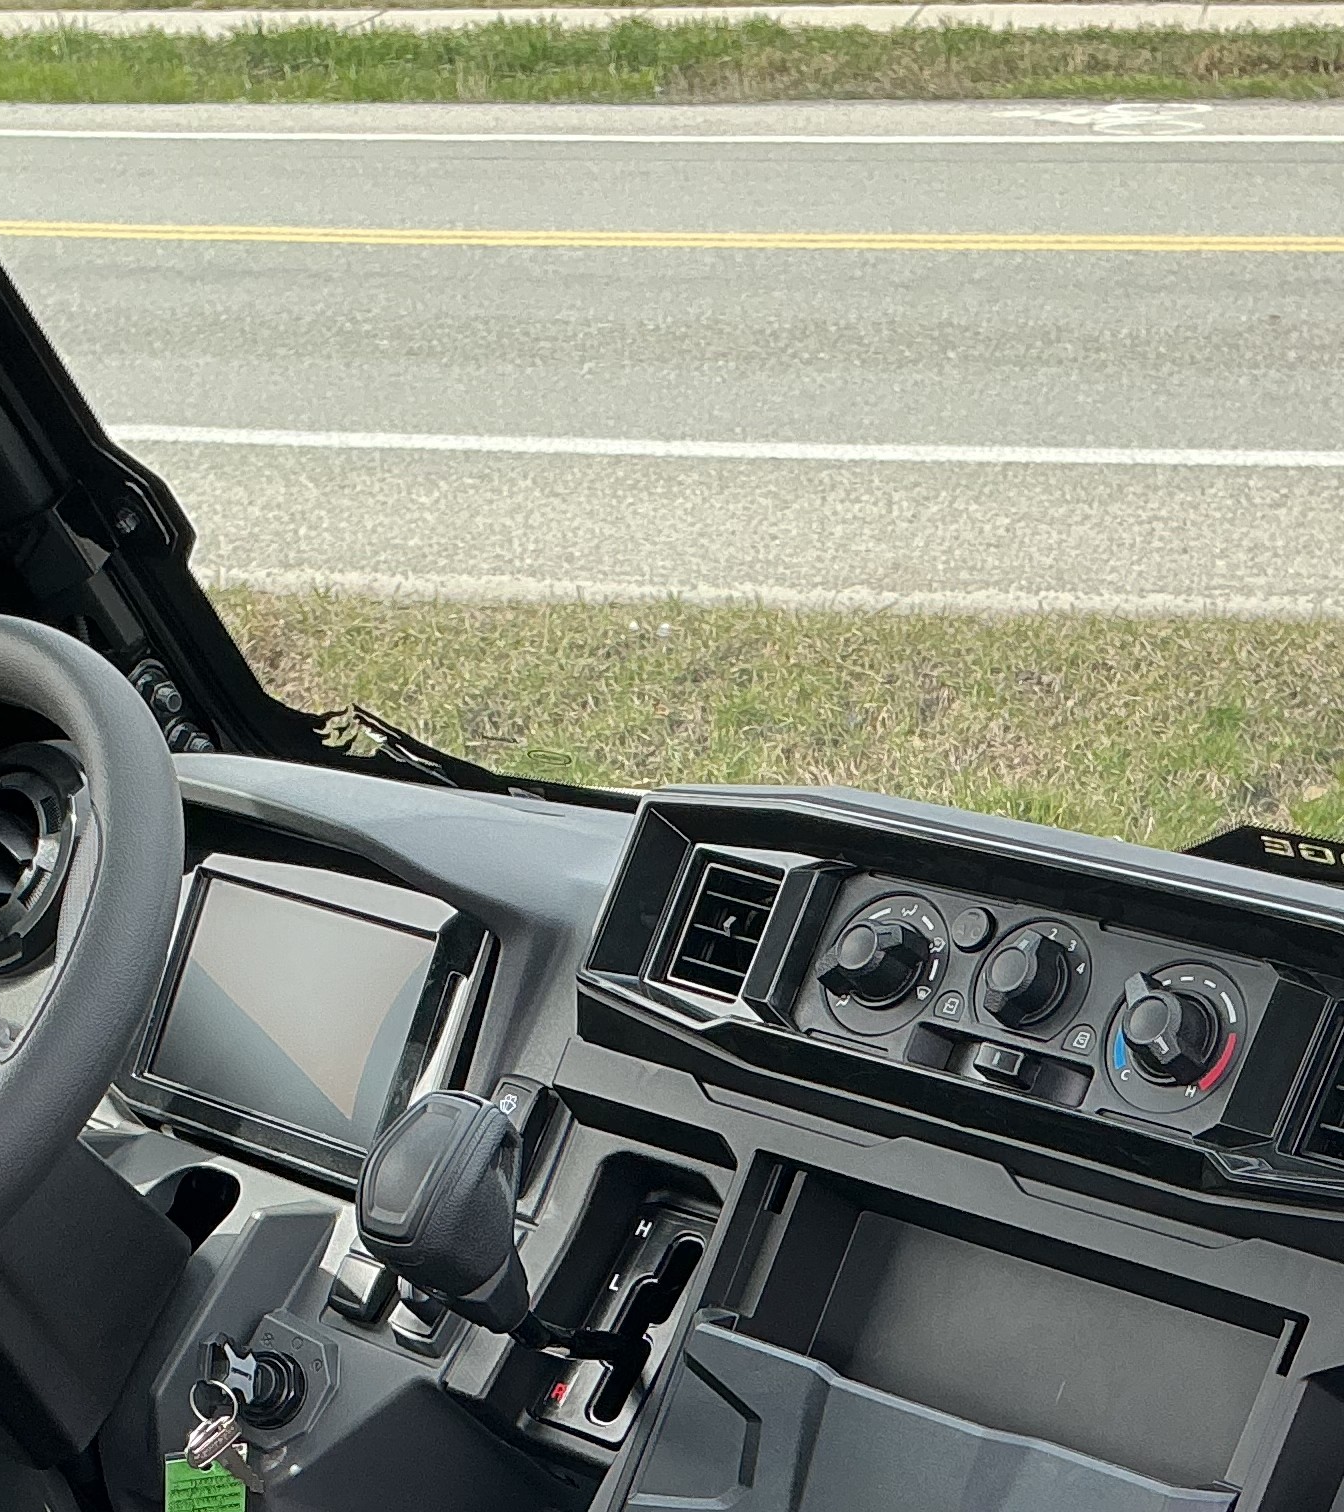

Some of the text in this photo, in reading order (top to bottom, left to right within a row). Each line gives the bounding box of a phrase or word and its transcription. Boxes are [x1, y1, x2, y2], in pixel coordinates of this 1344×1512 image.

[1047, 927, 1058, 942] 2
[1067, 939, 1077, 953] 3
[1076, 962, 1086, 975] 4
[1120, 1068, 1131, 1082] C
[1185, 1084, 1198, 1098] H
[634, 1218, 653, 1238] H
[608, 1273, 621, 1292] L
[550, 1381, 569, 1402] R
